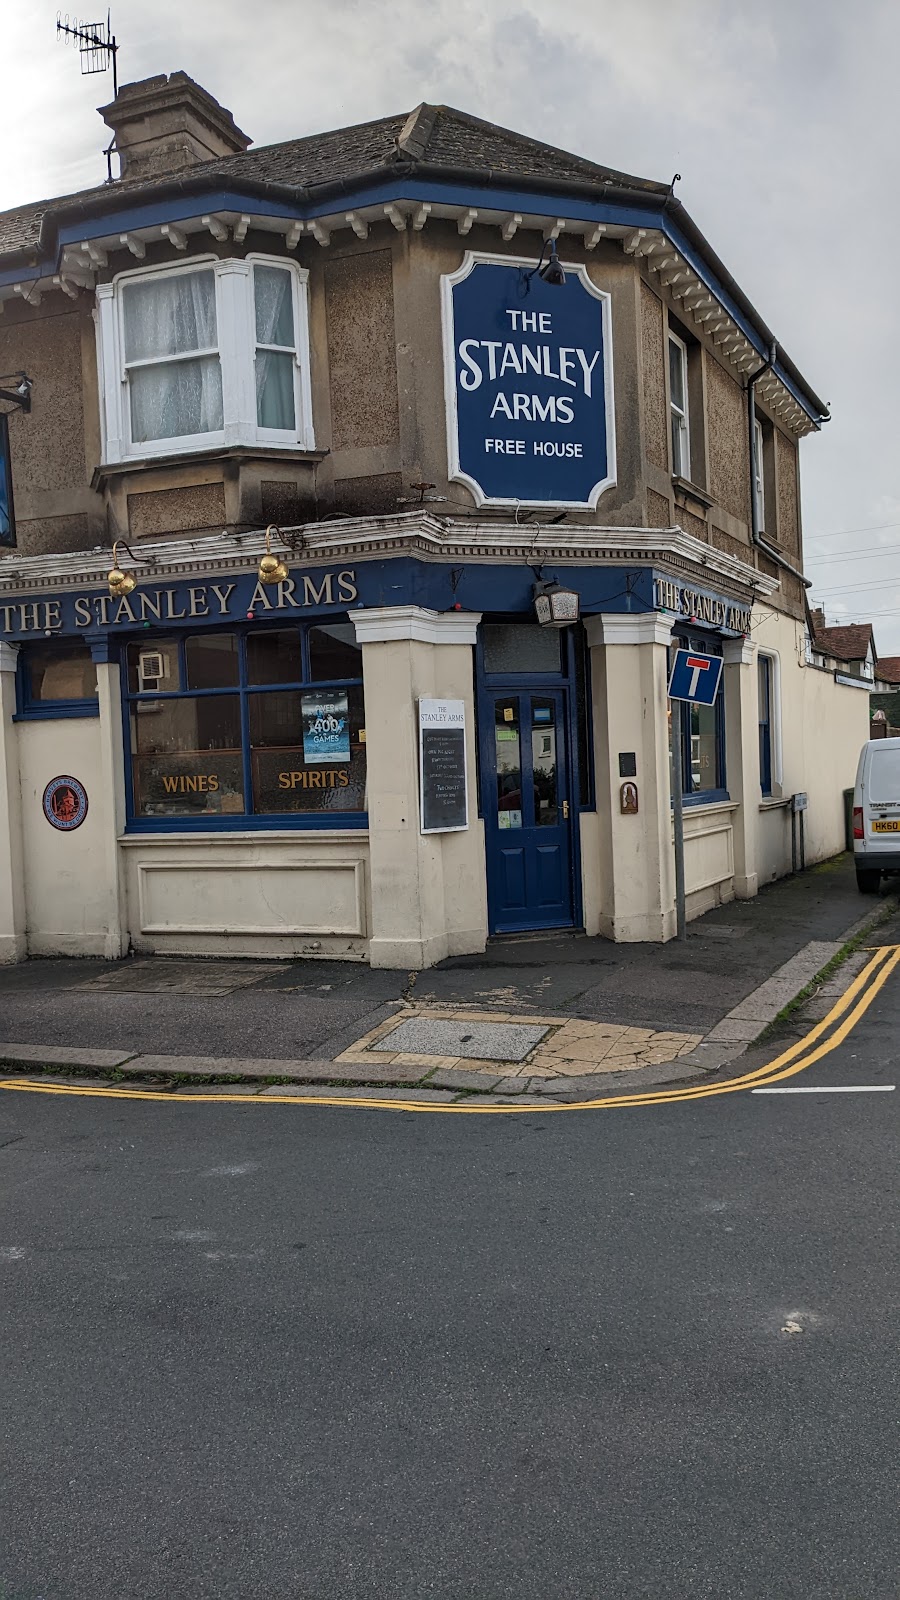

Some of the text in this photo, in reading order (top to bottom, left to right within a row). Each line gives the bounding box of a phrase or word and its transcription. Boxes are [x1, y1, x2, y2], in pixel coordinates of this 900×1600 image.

[505, 309, 553, 334] THE
[458, 338, 601, 399] STANLEY
[489, 392, 575, 424] ARMS
[485, 438, 584, 458] FREE HOUSE
[0, 570, 358, 633] THE STANLEY ARMS
[656, 579, 751, 634] THE STANLEY ARMS
[314, 704, 334, 714] OVER
[420, 713, 464, 722] STANLEY ARMS
[314, 719, 338, 732] 400
[314, 734, 339, 742] GAMES
[162, 774, 219, 793] WINES
[278, 769, 349, 790] SPIRITS
[875, 821, 898, 830] HK60
